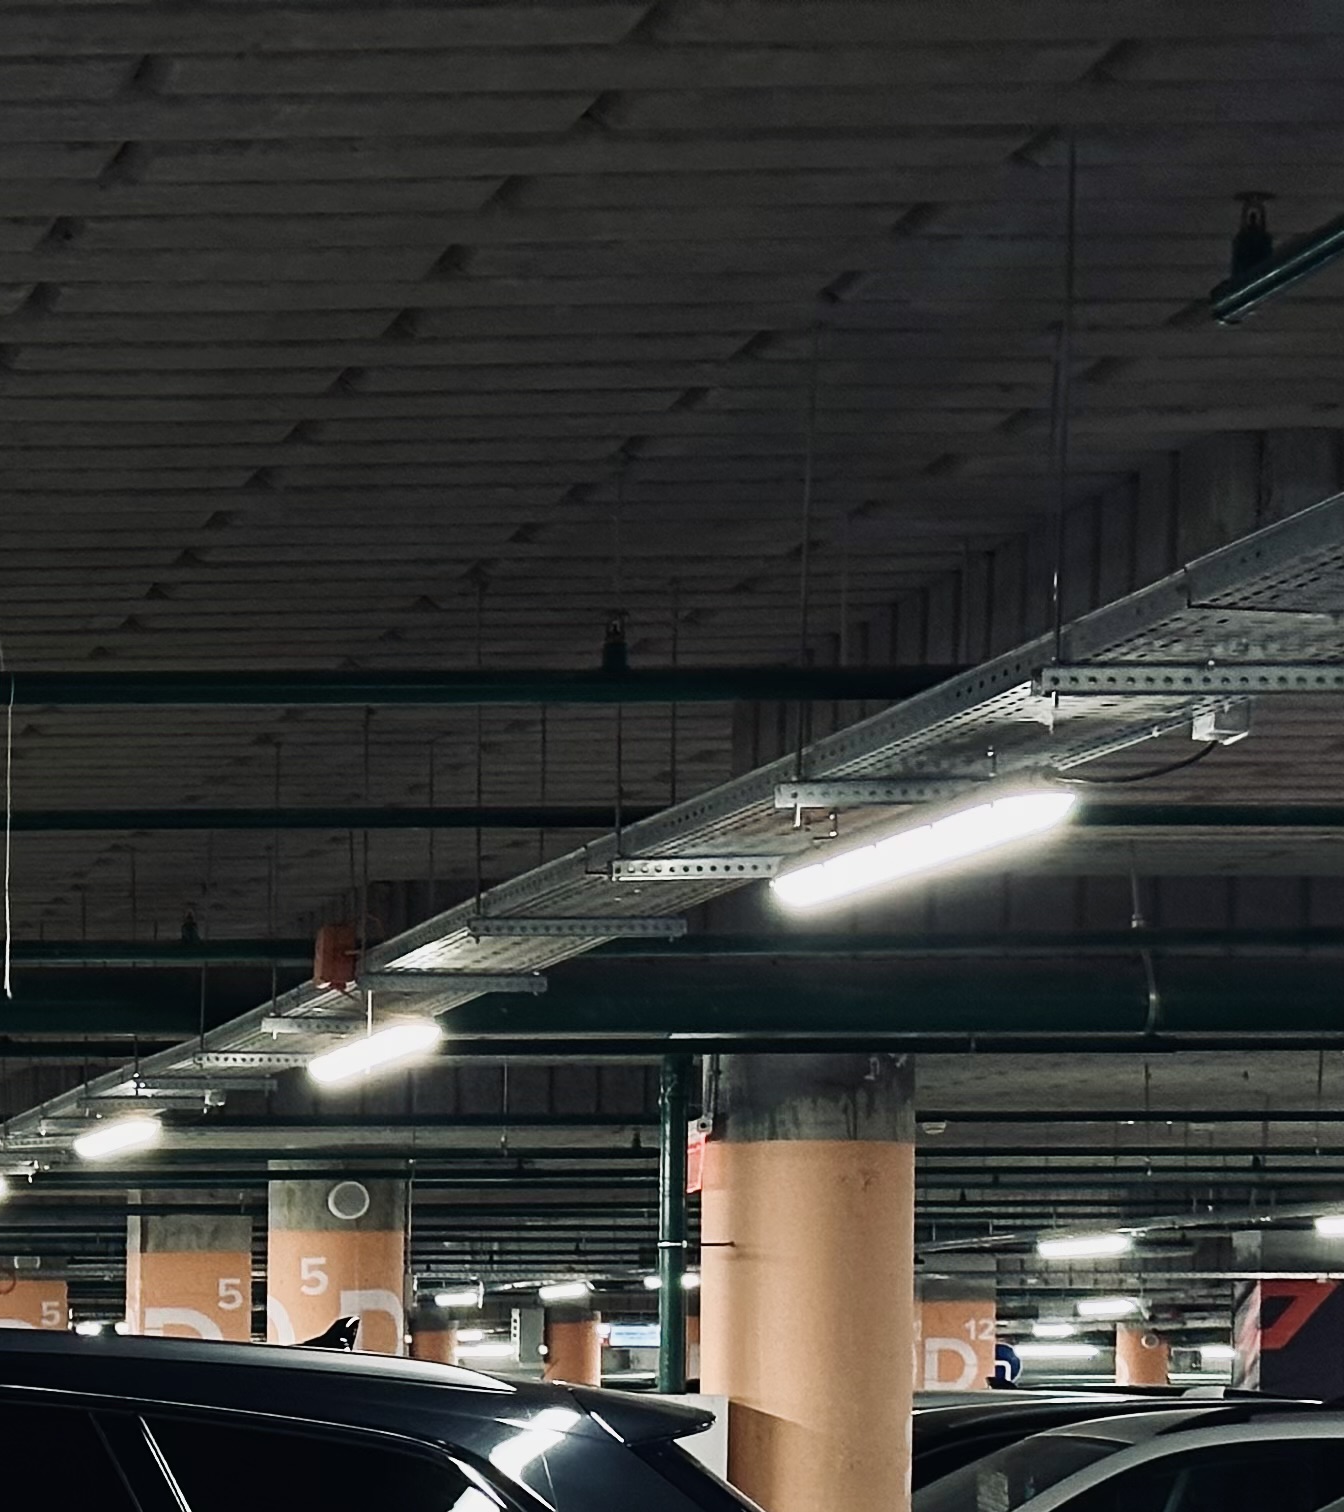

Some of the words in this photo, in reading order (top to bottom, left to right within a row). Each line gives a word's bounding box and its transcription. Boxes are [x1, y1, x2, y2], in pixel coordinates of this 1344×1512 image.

[301, 1257, 329, 1296] 5
[218, 1277, 244, 1310] 5
[41, 1301, 61, 1327] 5
[964, 1317, 994, 1340] 12
[924, 1337, 978, 1390] D
